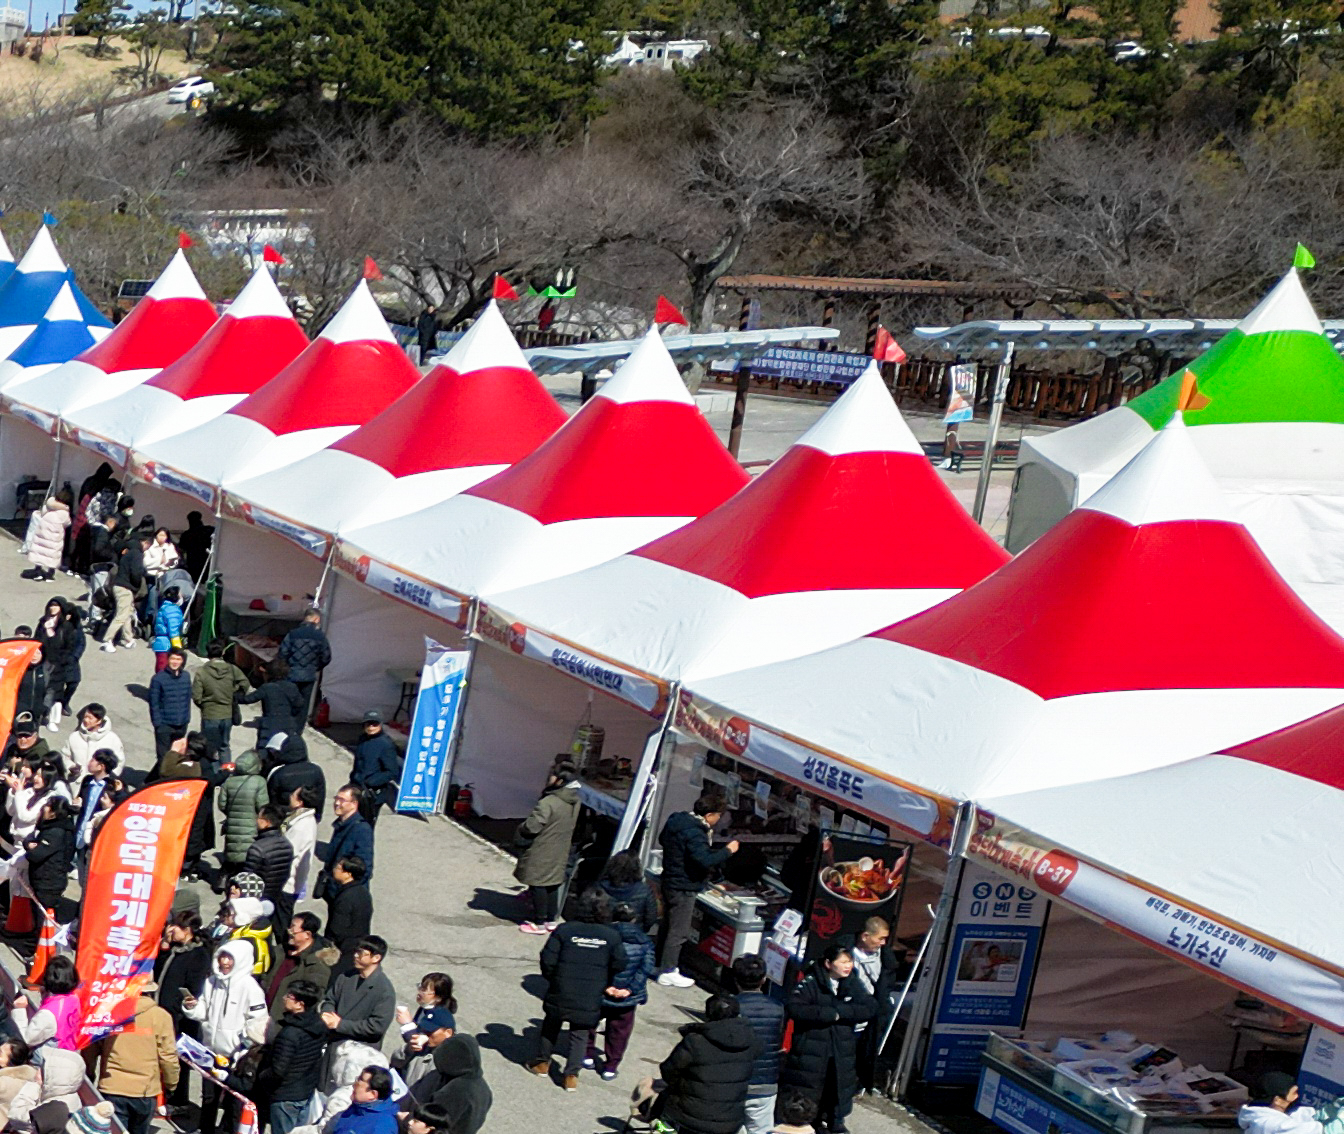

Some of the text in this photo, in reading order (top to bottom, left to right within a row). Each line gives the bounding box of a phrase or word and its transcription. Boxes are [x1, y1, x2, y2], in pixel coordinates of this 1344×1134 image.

[127, 802, 167, 816] 제27회
[1036, 858, 1074, 885] B-37
[99, 815, 163, 977] 영덕대게축제
[970, 900, 1034, 919] 이벤트
[1166, 926, 1229, 969] 노가수산
